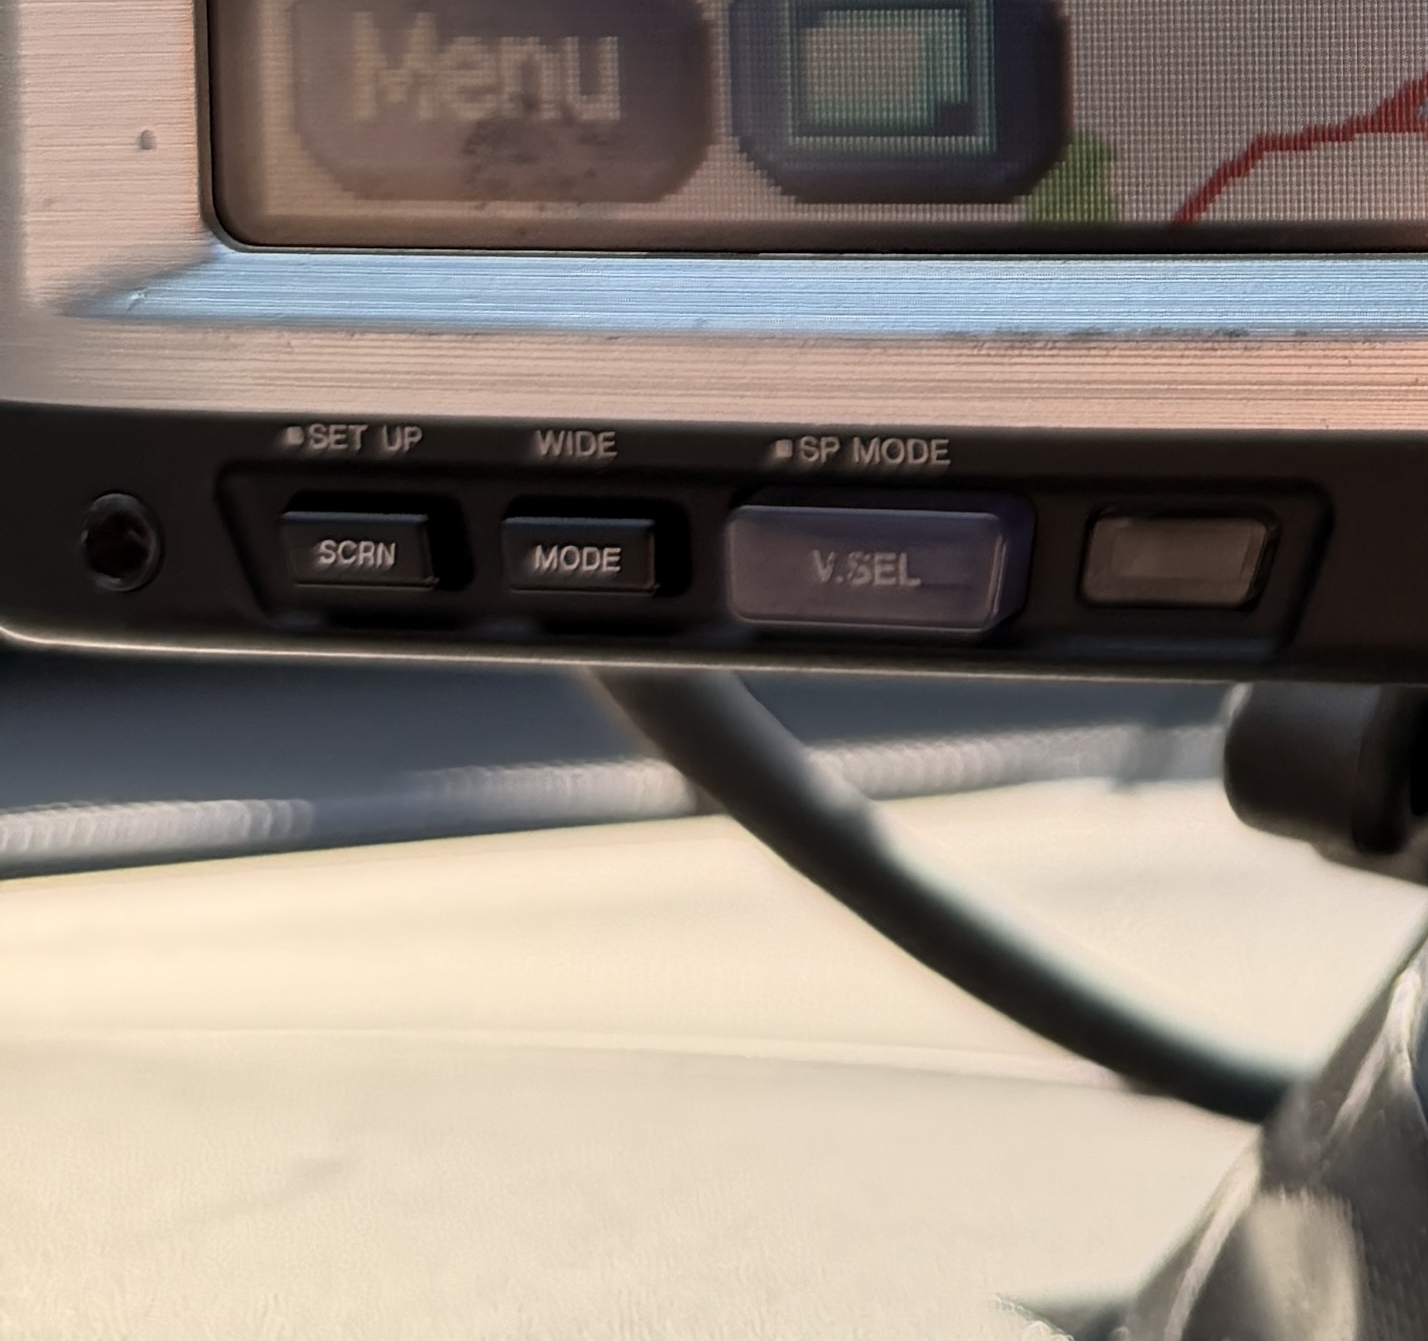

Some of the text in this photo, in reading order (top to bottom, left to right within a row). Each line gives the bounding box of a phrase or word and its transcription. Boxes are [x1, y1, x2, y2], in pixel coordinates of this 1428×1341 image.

[351, 11, 622, 121] Menu
[307, 423, 424, 453] SET UP
[534, 429, 618, 459] WIDE
[800, 436, 951, 466] SP MODE
[317, 539, 396, 568] SCRN
[533, 544, 622, 573] MODE
[812, 550, 921, 587] V.SEL
